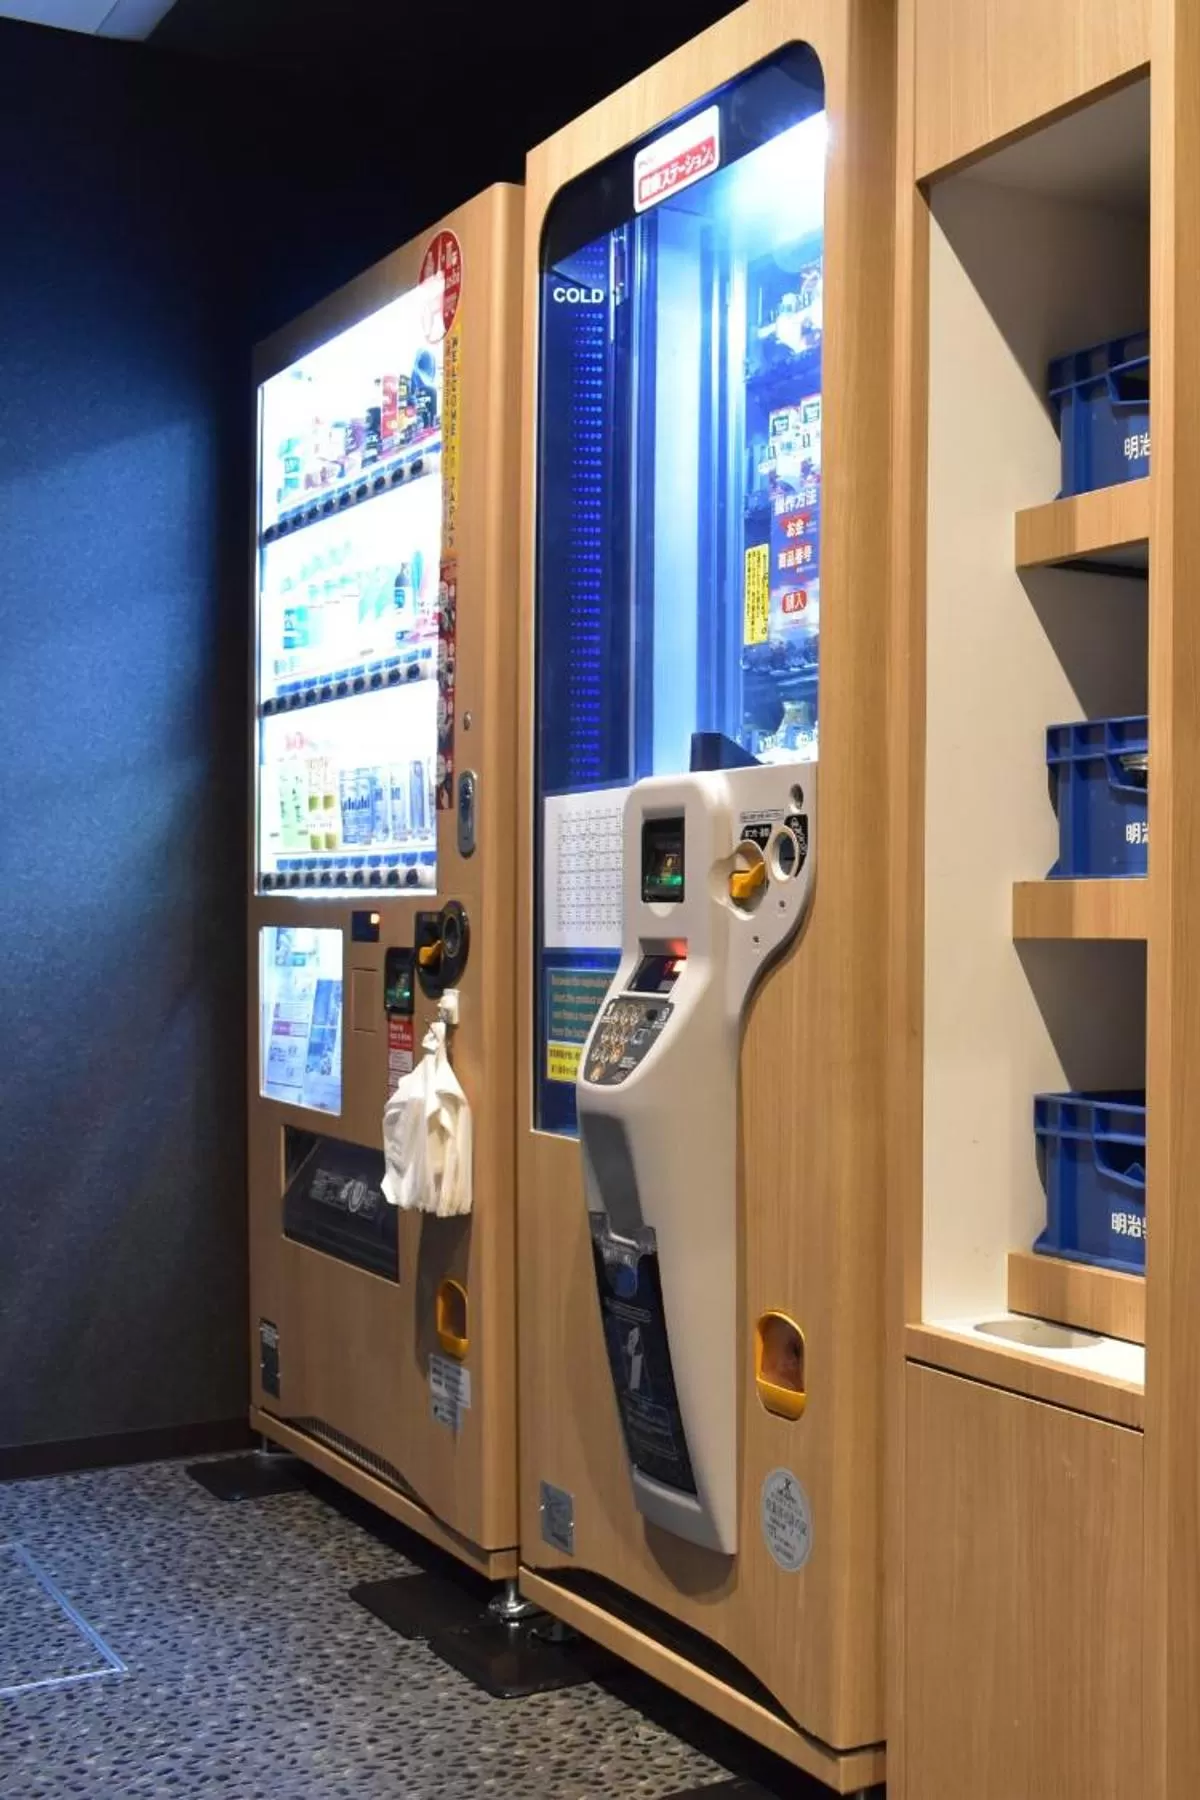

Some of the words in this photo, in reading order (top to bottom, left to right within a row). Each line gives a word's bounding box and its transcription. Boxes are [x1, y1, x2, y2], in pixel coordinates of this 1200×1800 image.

[553, 287, 604, 304] COLD
[1124, 432, 1151, 460] 明治
[1111, 1212, 1148, 1238] 明治
